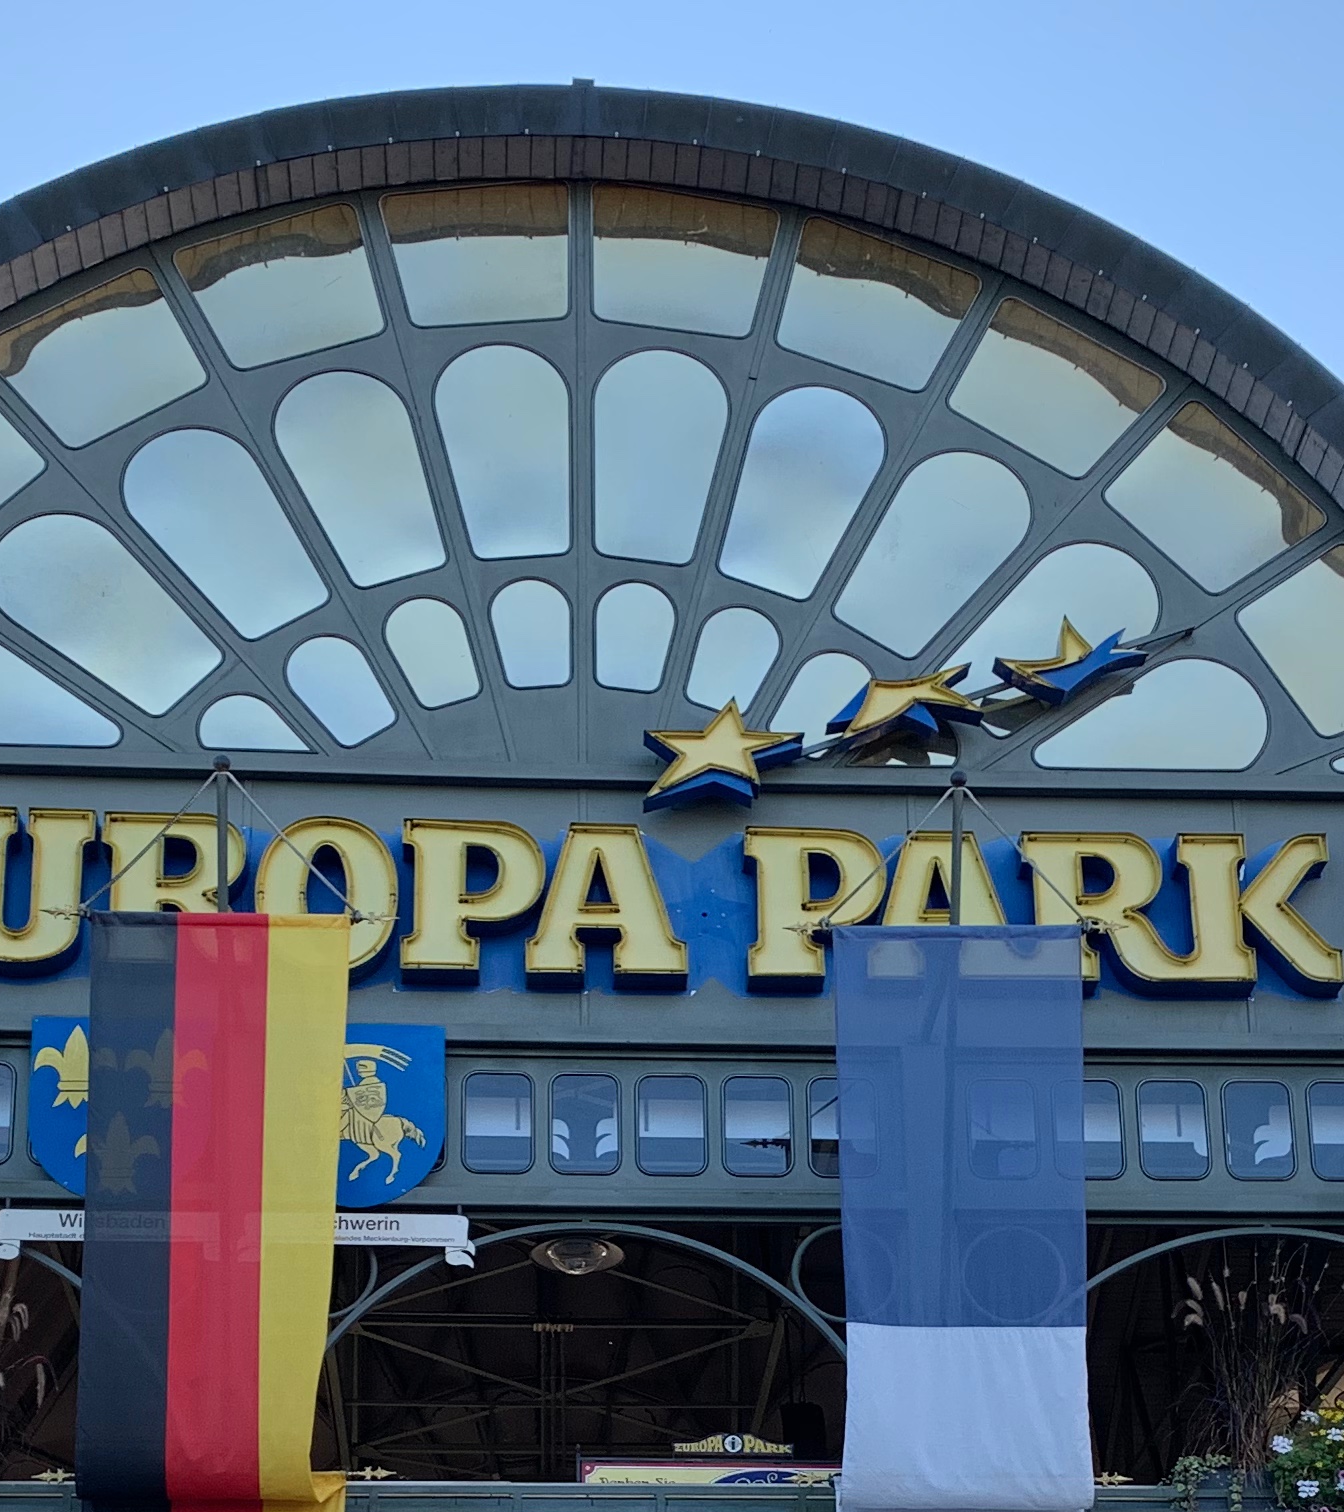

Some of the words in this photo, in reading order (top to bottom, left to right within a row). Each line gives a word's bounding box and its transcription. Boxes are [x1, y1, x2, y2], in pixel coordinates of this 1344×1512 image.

[743, 825, 1344, 997] PARK
[59, 1212, 166, 1231] Wisbaden
[320, 1214, 400, 1232] hwerin
[674, 1434, 724, 1452] EUROPA
[744, 1434, 793, 1454] PARK
